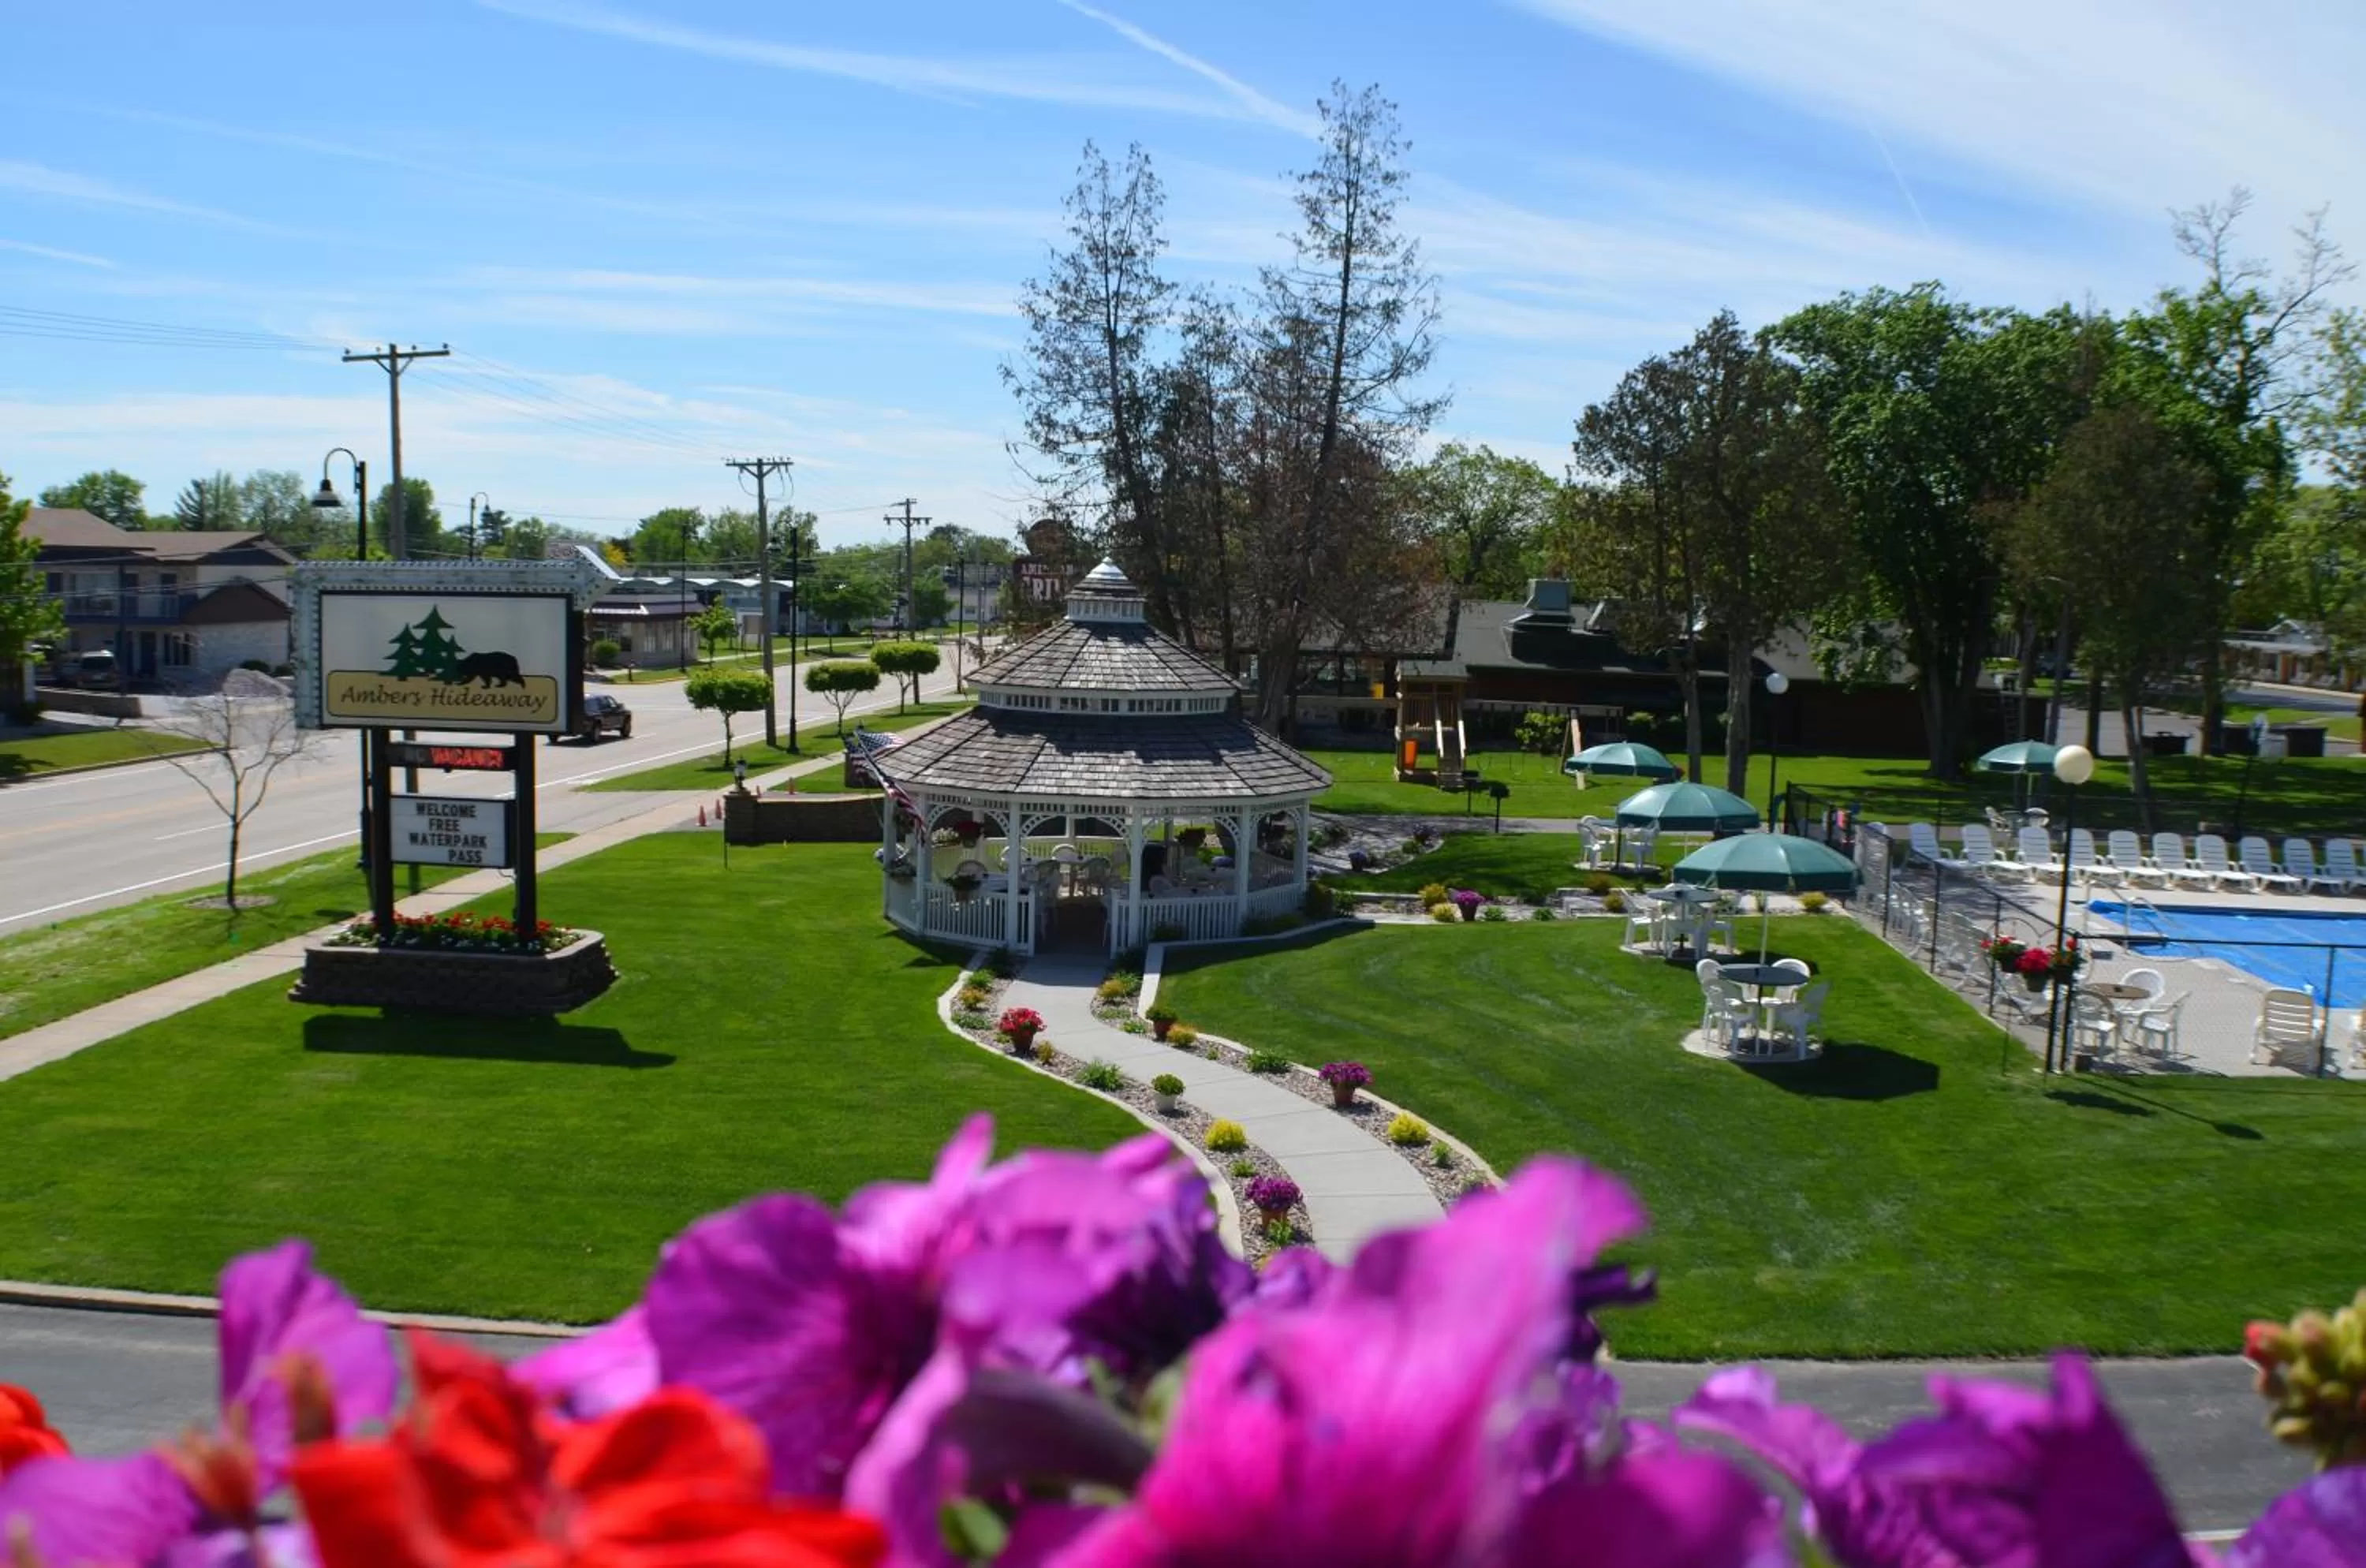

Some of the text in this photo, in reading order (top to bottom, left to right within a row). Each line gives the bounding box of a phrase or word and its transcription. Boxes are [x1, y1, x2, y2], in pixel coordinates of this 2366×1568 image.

[340, 684, 548, 714] Ambers Hideaway
[416, 802, 477, 818] WELCOME
[428, 818, 461, 832] FREE
[409, 832, 488, 849] WATERPARK
[447, 848, 483, 864] PASS
